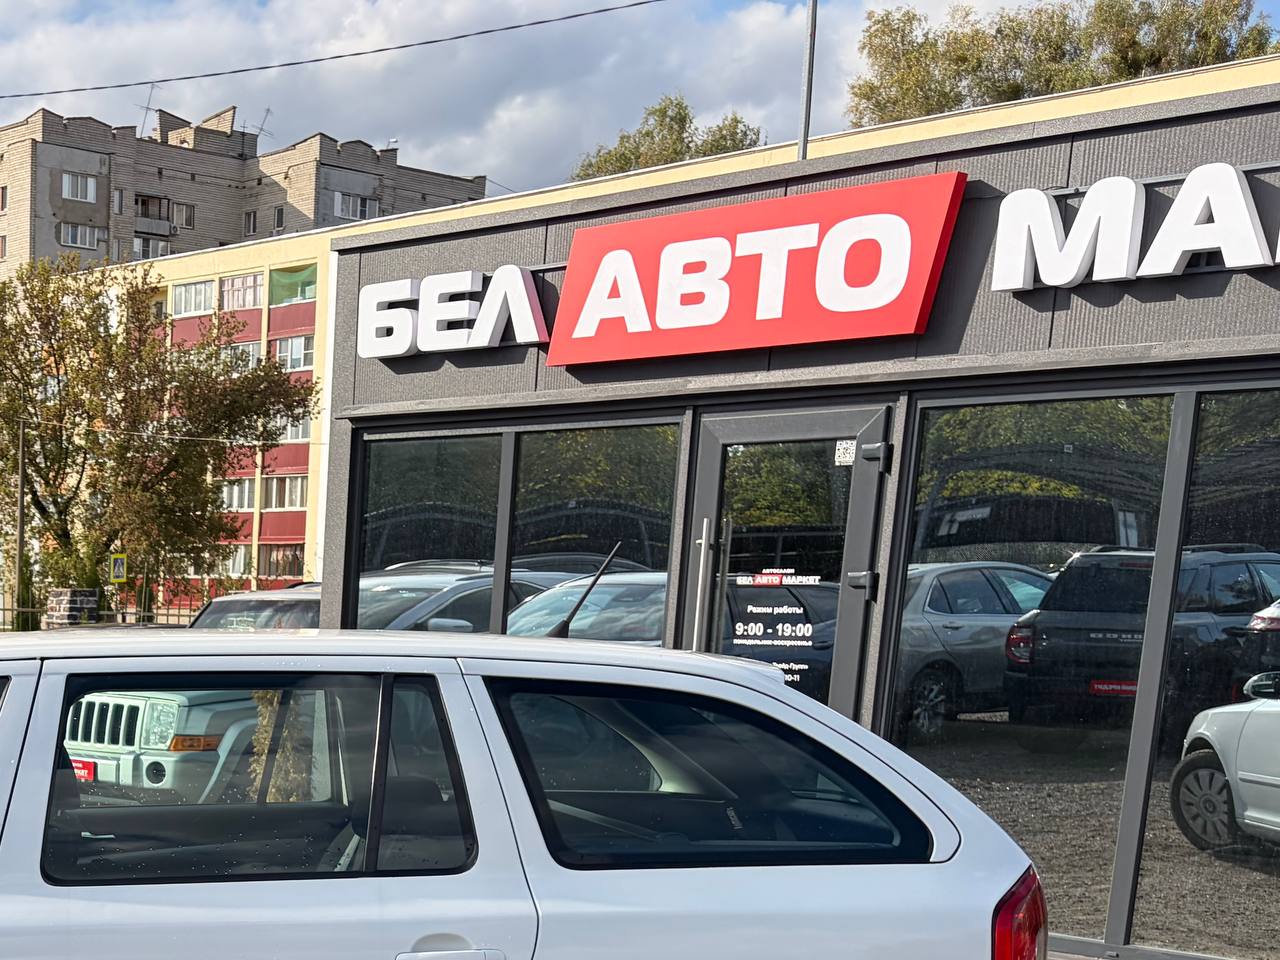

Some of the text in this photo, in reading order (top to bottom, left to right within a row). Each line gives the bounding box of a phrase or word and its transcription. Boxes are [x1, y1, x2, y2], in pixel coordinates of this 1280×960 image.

[357, 162, 1280, 359] БЕЛ АВТО МА
[755, 576, 780, 584] АВТО
[782, 575, 821, 585] МАРКЕТ
[773, 605, 803, 615] работы
[735, 622, 764, 636] 9:00
[776, 623, 813, 637] 19:00
